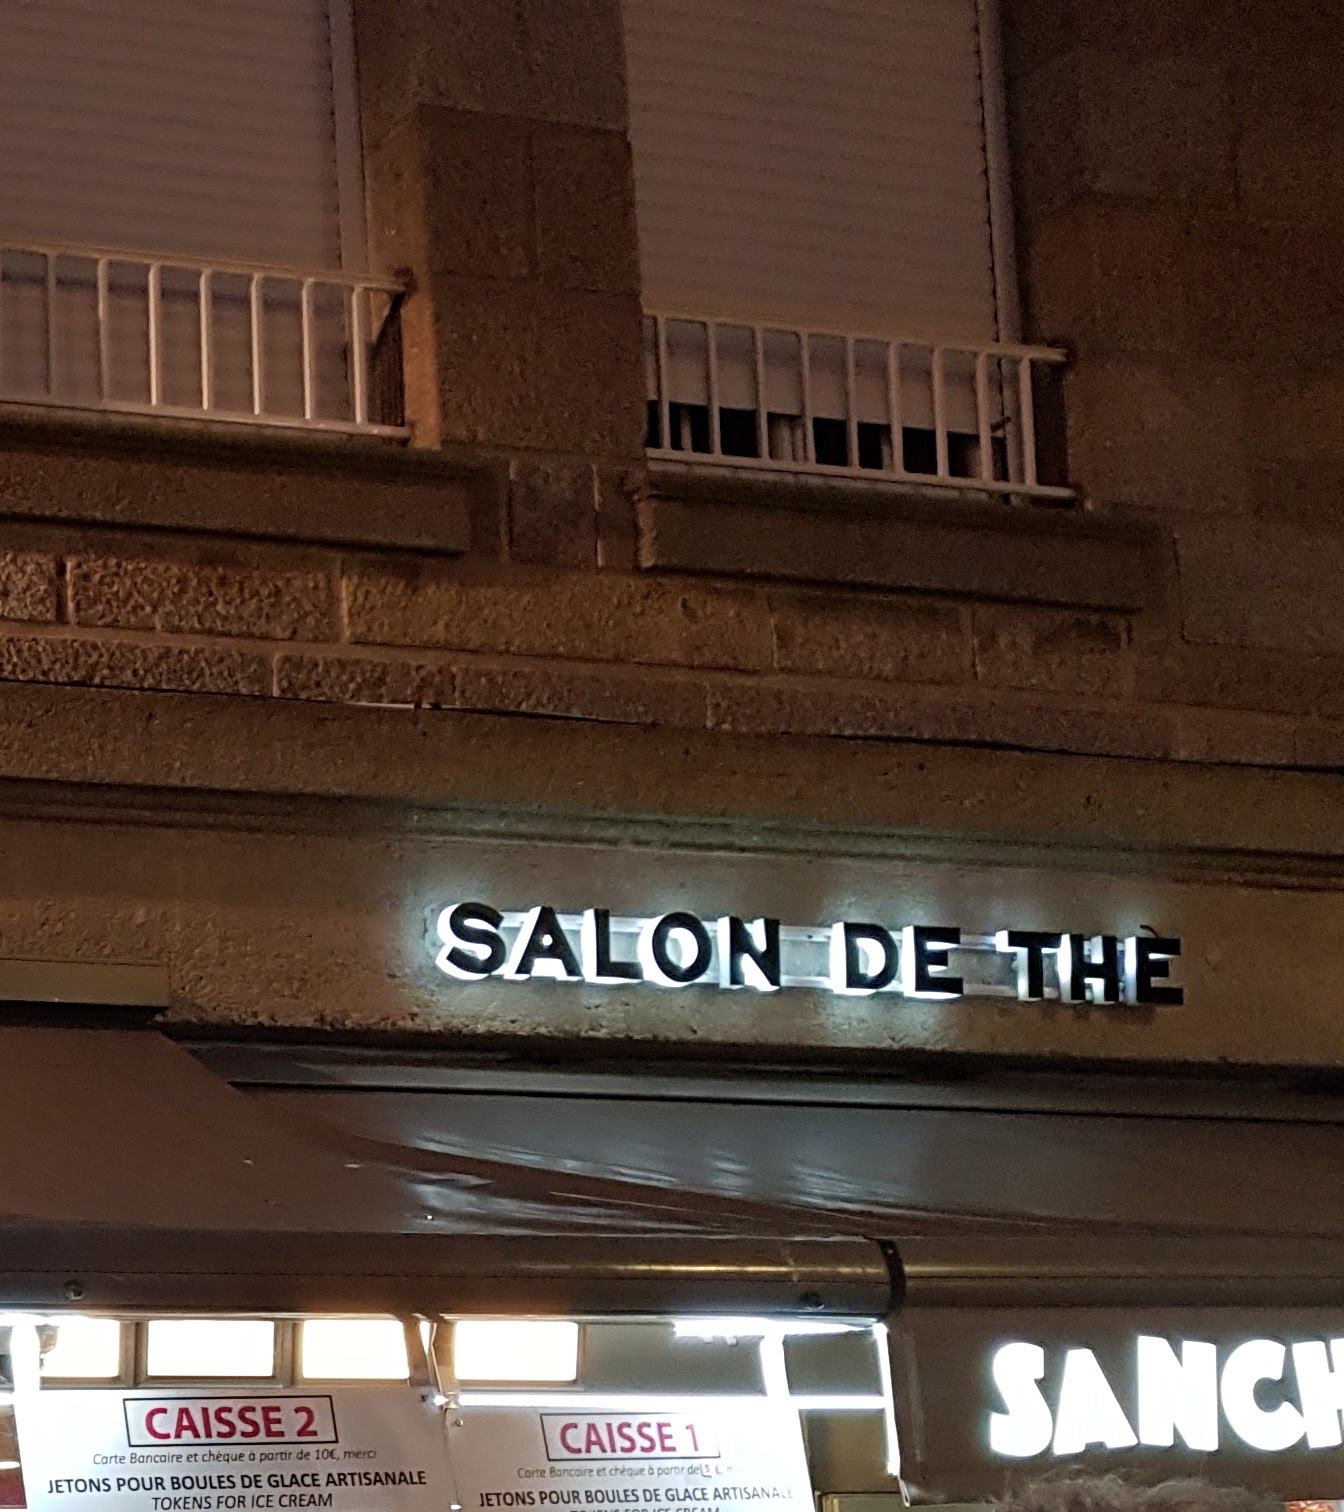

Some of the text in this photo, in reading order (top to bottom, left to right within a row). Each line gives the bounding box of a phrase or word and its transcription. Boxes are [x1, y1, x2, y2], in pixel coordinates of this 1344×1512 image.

[437, 902, 782, 990] SALON
[832, 920, 963, 1000] DE
[145, 1406, 318, 1440] CAISSE 2
[559, 1422, 700, 1454] CAISSE 1
[93, 1453, 126, 1465] Carte
[130, 1451, 182, 1464] Bancaire
[186, 1451, 199, 1463] et
[201, 1450, 244, 1466] chèque
[259, 1449, 293, 1465] partir
[296, 1449, 310, 1461] de
[47, 1470, 427, 1495] JETONS POUR BOULES DE GLACE ARTISANALE
[597, 1466, 606, 1477] et
[152, 1492, 333, 1511] TOKENS FOR ICE CREAM
[479, 1485, 794, 1507] JETONS POUR BOULES DE GLACE ARTISANALE
